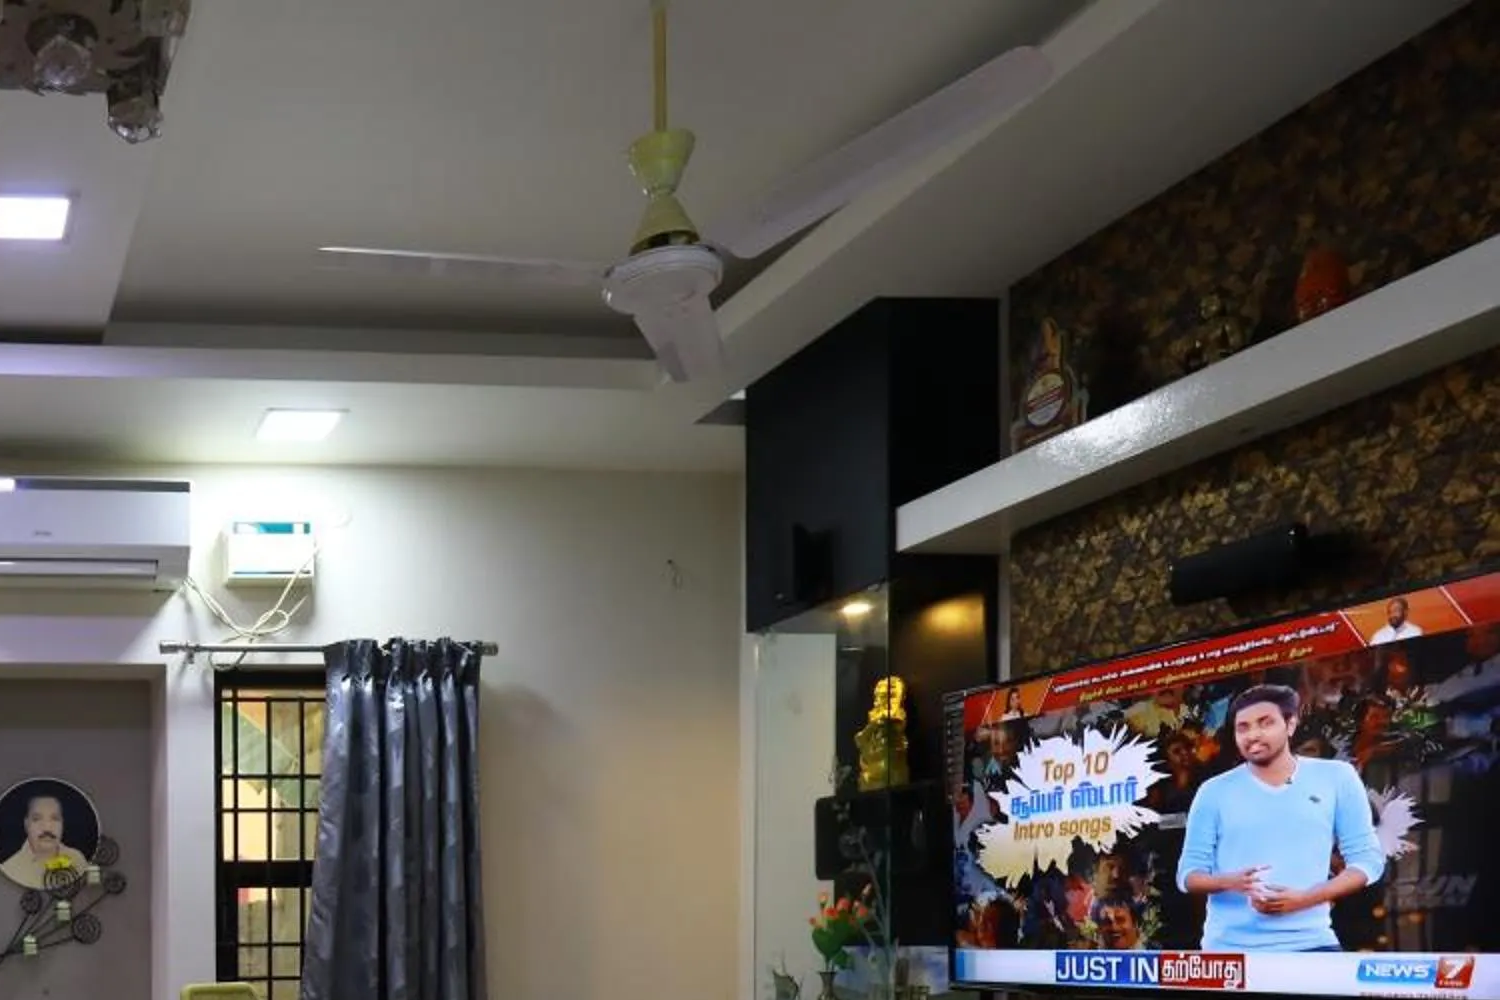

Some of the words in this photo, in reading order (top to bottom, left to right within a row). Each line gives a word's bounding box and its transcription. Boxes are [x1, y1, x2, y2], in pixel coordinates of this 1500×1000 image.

[1042, 759, 1075, 785] Top
[1083, 751, 1109, 776] 10
[1011, 785, 1064, 818] சூப்பர்
[1070, 776, 1138, 809] ஸ்டார்
[1013, 821, 1055, 841] Intro
[1059, 816, 1112, 839] songs
[1057, 955, 1122, 981] JUST
[1130, 956, 1159, 983] IN
[1161, 953, 1242, 988] தற்போது
[1365, 963, 1431, 978] NEWS
[1444, 959, 1470, 979] 7
